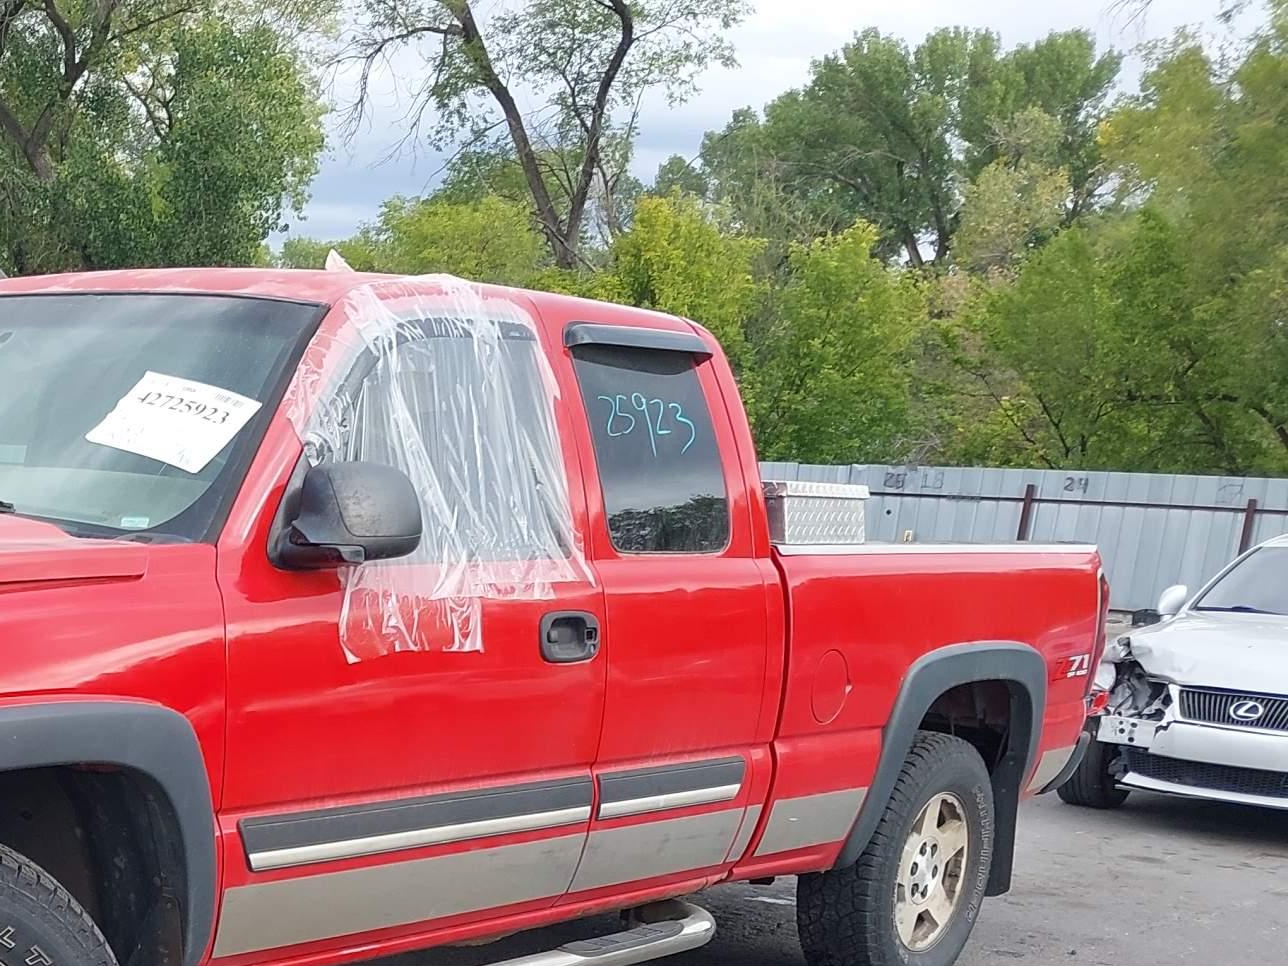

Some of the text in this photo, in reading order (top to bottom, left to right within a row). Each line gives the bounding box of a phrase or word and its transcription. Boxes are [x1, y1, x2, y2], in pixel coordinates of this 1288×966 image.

[137, 391, 231, 425] 42725923
[597, 392, 696, 458] 25923
[1053, 653, 1090, 681] Z71
